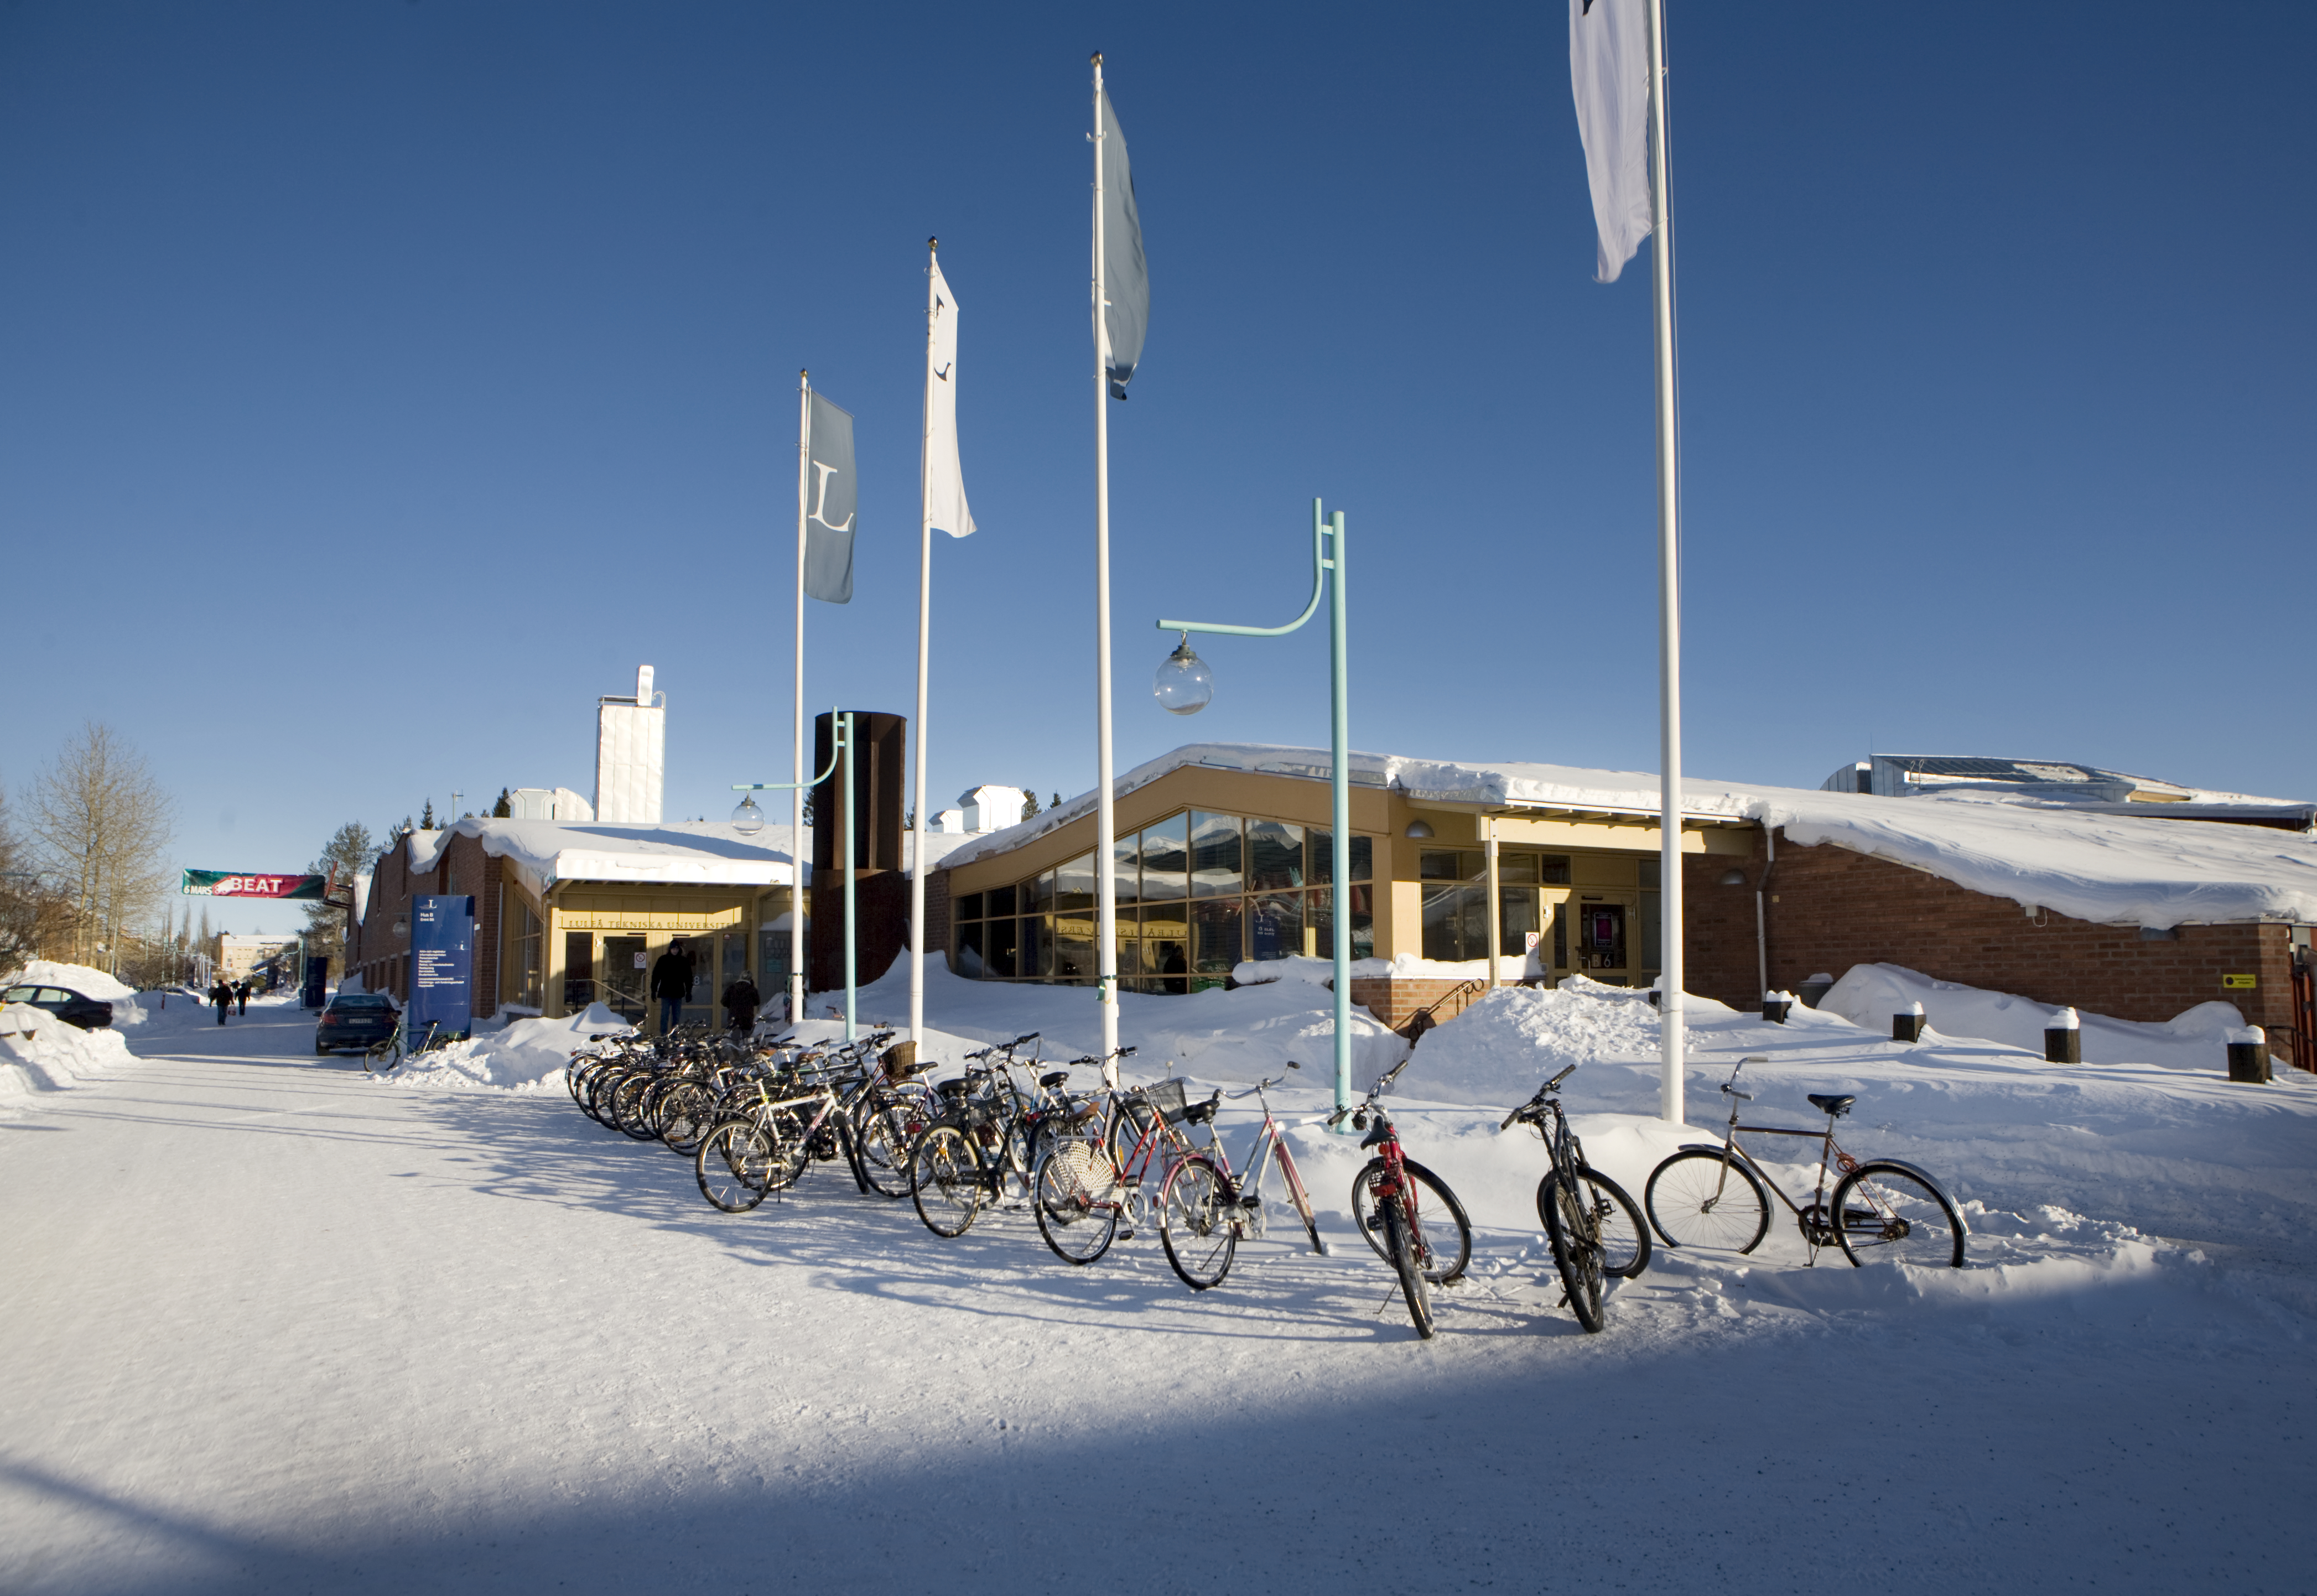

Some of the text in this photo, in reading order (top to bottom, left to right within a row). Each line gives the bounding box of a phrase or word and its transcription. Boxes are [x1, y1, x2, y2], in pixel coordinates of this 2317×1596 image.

[808, 460, 854, 532] L
[184, 886, 212, 895] 6 MARS
[231, 877, 282, 892] BEAT
[569, 919, 603, 928] LULEÅ
[1604, 954, 1611, 968] 6
